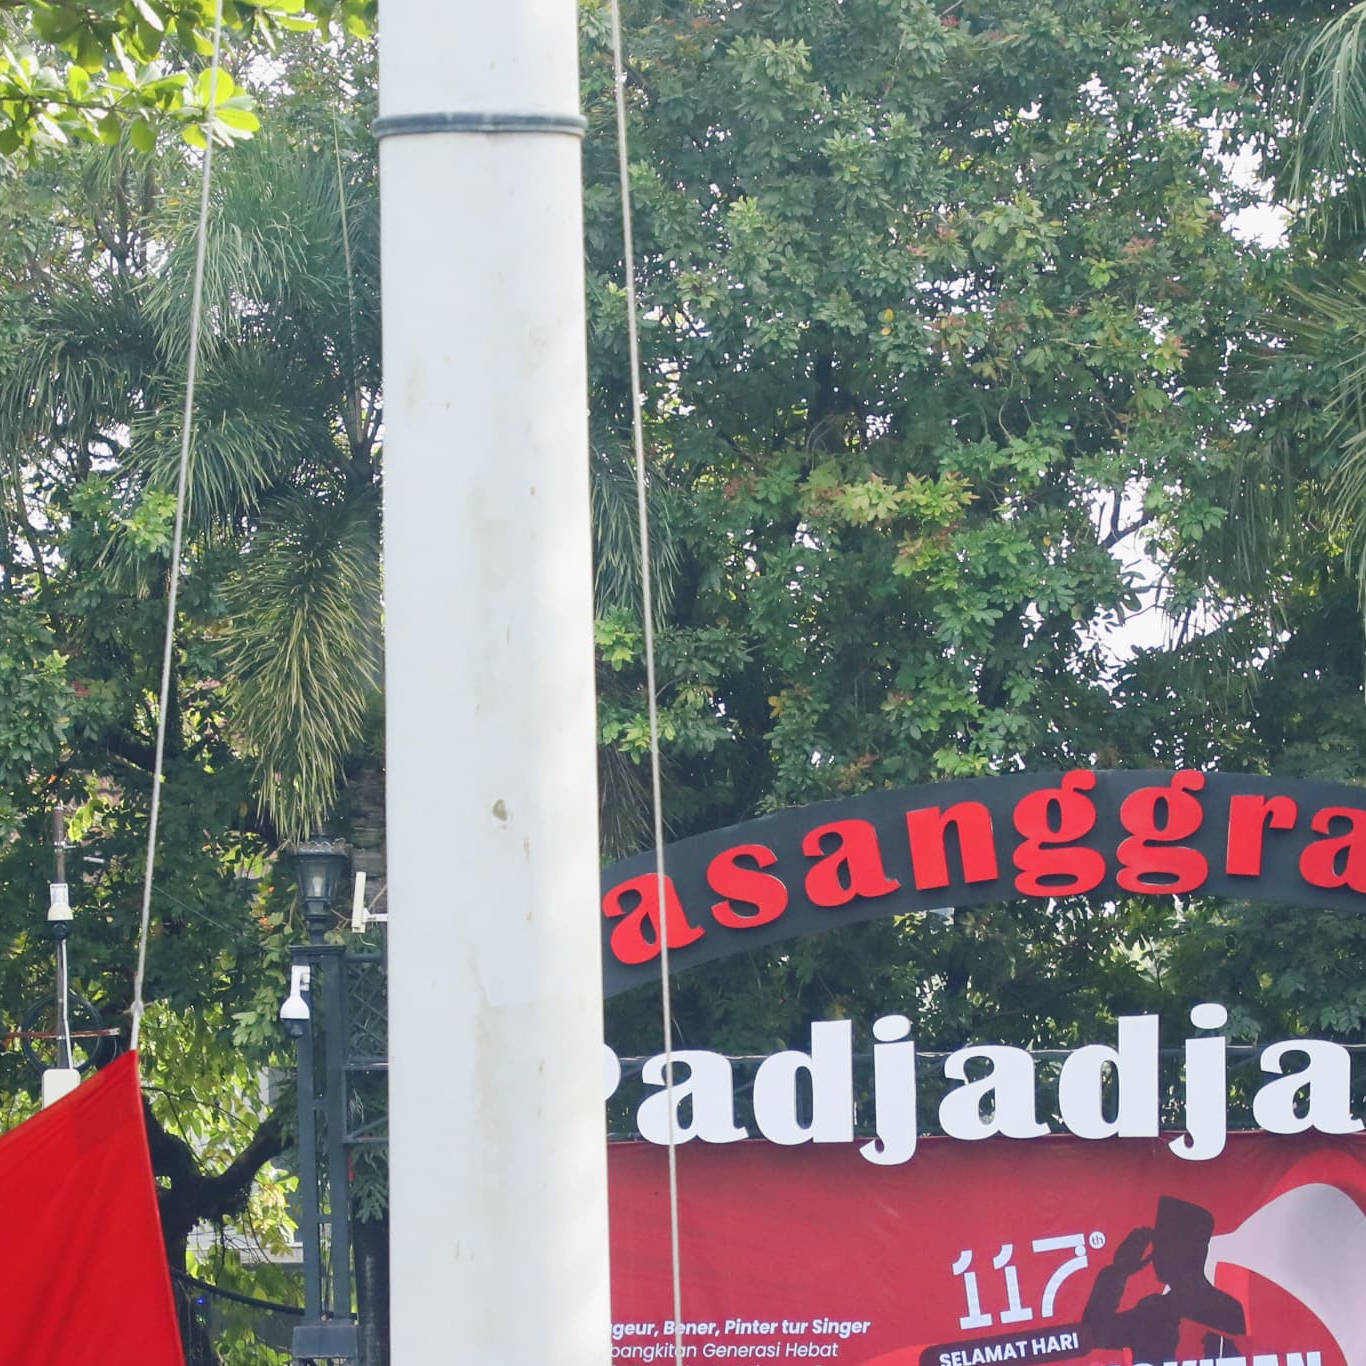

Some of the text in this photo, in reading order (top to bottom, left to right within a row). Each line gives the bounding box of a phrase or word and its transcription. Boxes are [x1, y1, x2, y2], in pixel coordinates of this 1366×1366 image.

[610, 1317, 871, 1340] geur, Bener, Pinter tur Singer
[702, 1342, 780, 1358] Generasi
[785, 1342, 839, 1358] Hebat
[1031, 1332, 1079, 1355] HARI
